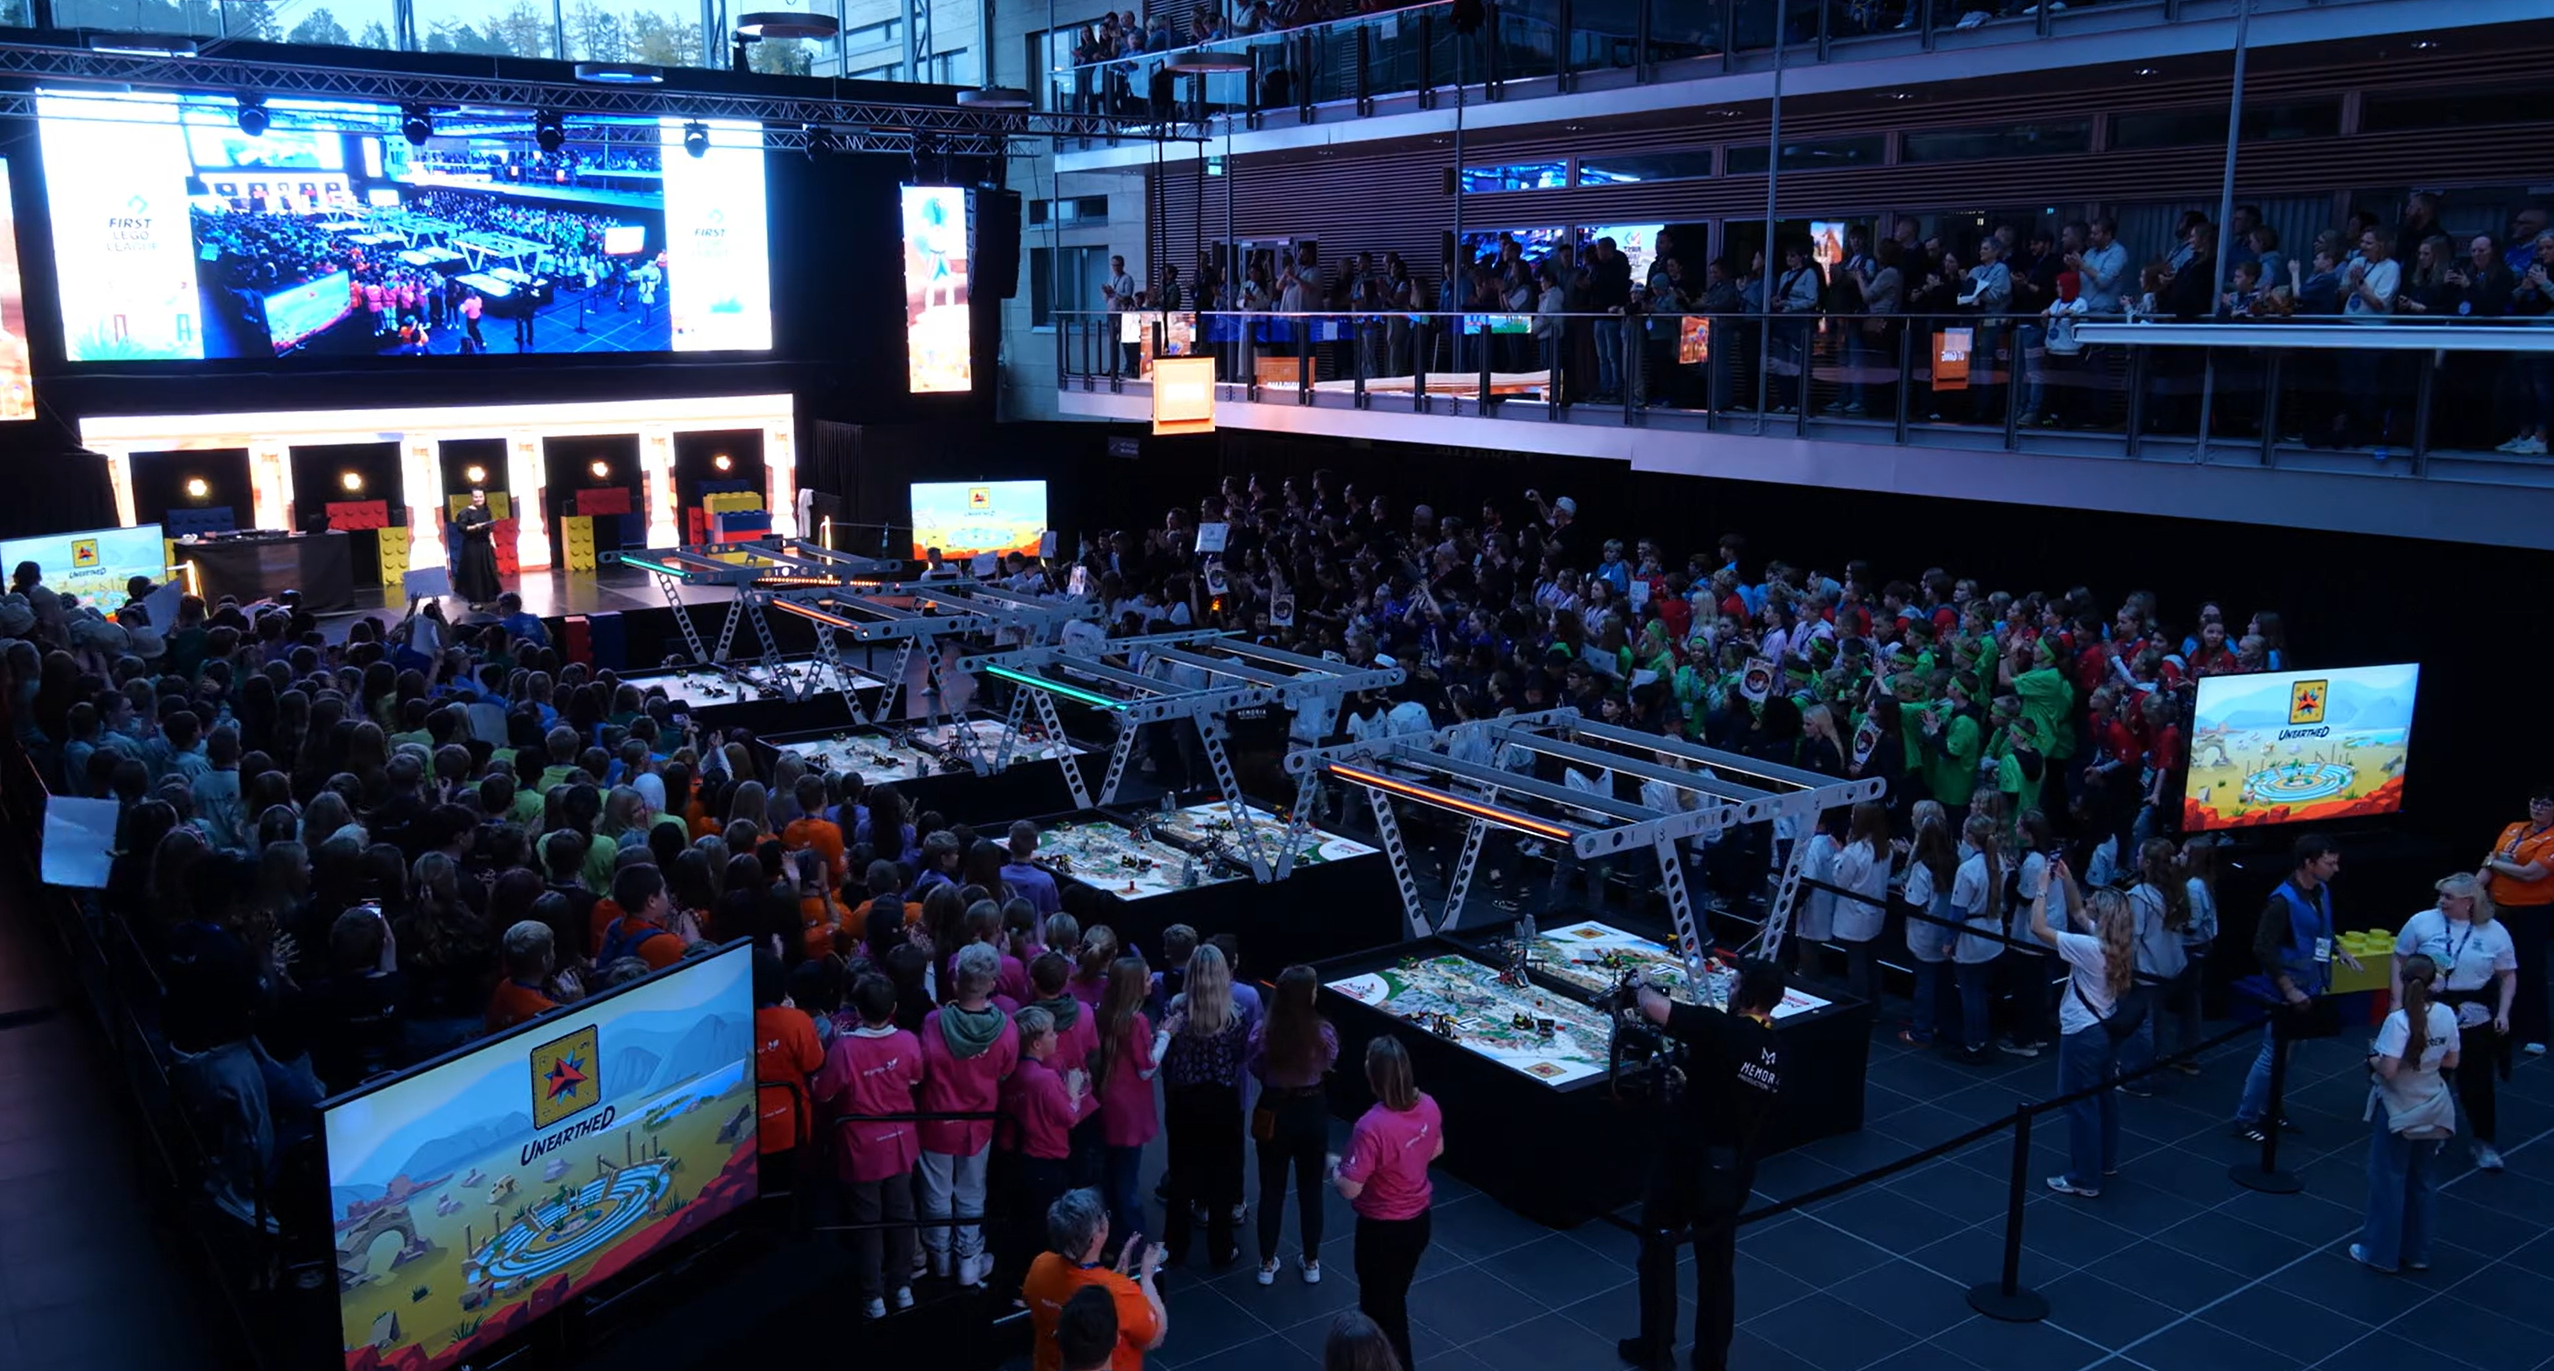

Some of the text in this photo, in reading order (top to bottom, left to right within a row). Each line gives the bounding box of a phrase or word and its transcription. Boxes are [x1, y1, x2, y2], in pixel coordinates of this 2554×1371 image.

[109, 218, 152, 229] FIRST
[113, 230, 149, 241] LEGO
[694, 228, 726, 237] FIRST
[2278, 725, 2330, 741] UNEARTHED
[1740, 1061, 1780, 1086] MEMOR
[521, 1105, 615, 1166] UNEARTHED
